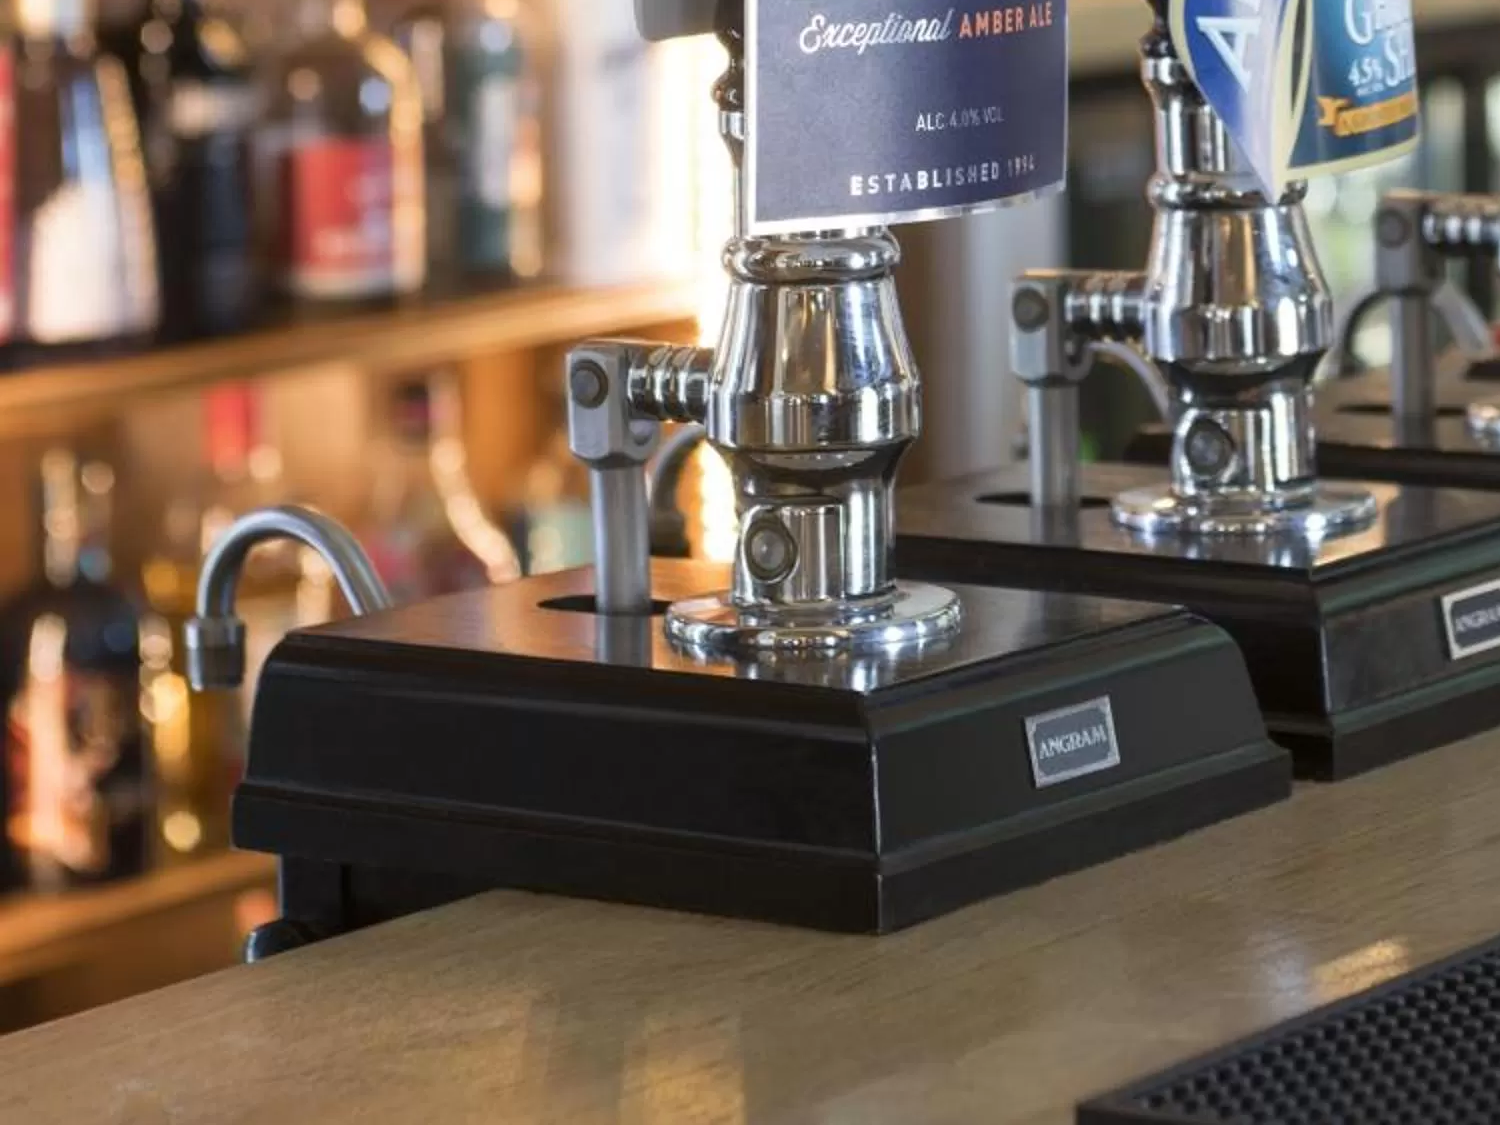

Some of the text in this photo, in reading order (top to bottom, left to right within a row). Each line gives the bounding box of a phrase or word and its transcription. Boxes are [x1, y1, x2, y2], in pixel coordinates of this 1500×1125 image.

[799, 1, 1053, 55] Exceptional AMBER ALE
[850, 161, 1000, 197] ESTABLISHED
[1039, 724, 1107, 760] ANGRAM
